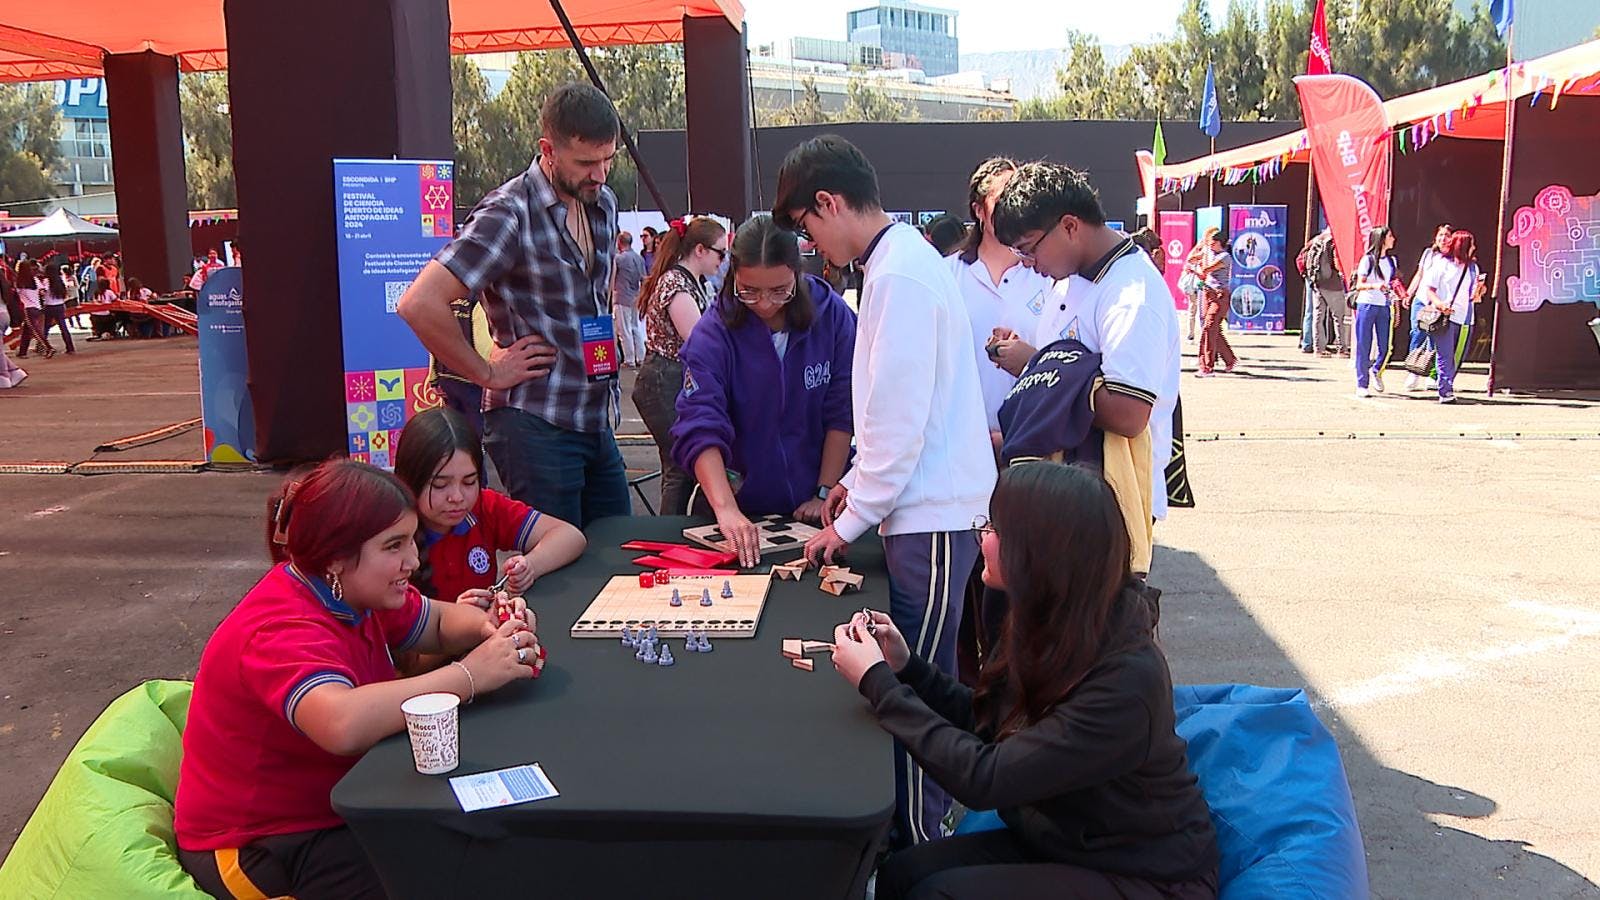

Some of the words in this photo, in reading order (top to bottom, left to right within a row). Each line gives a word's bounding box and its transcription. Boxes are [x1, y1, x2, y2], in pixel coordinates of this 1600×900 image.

[343, 192, 376, 200] FESTIVAL
[387, 267, 420, 275] Antofagasta
[804, 361, 831, 390] G24
[413, 722, 437, 731] Mocca
